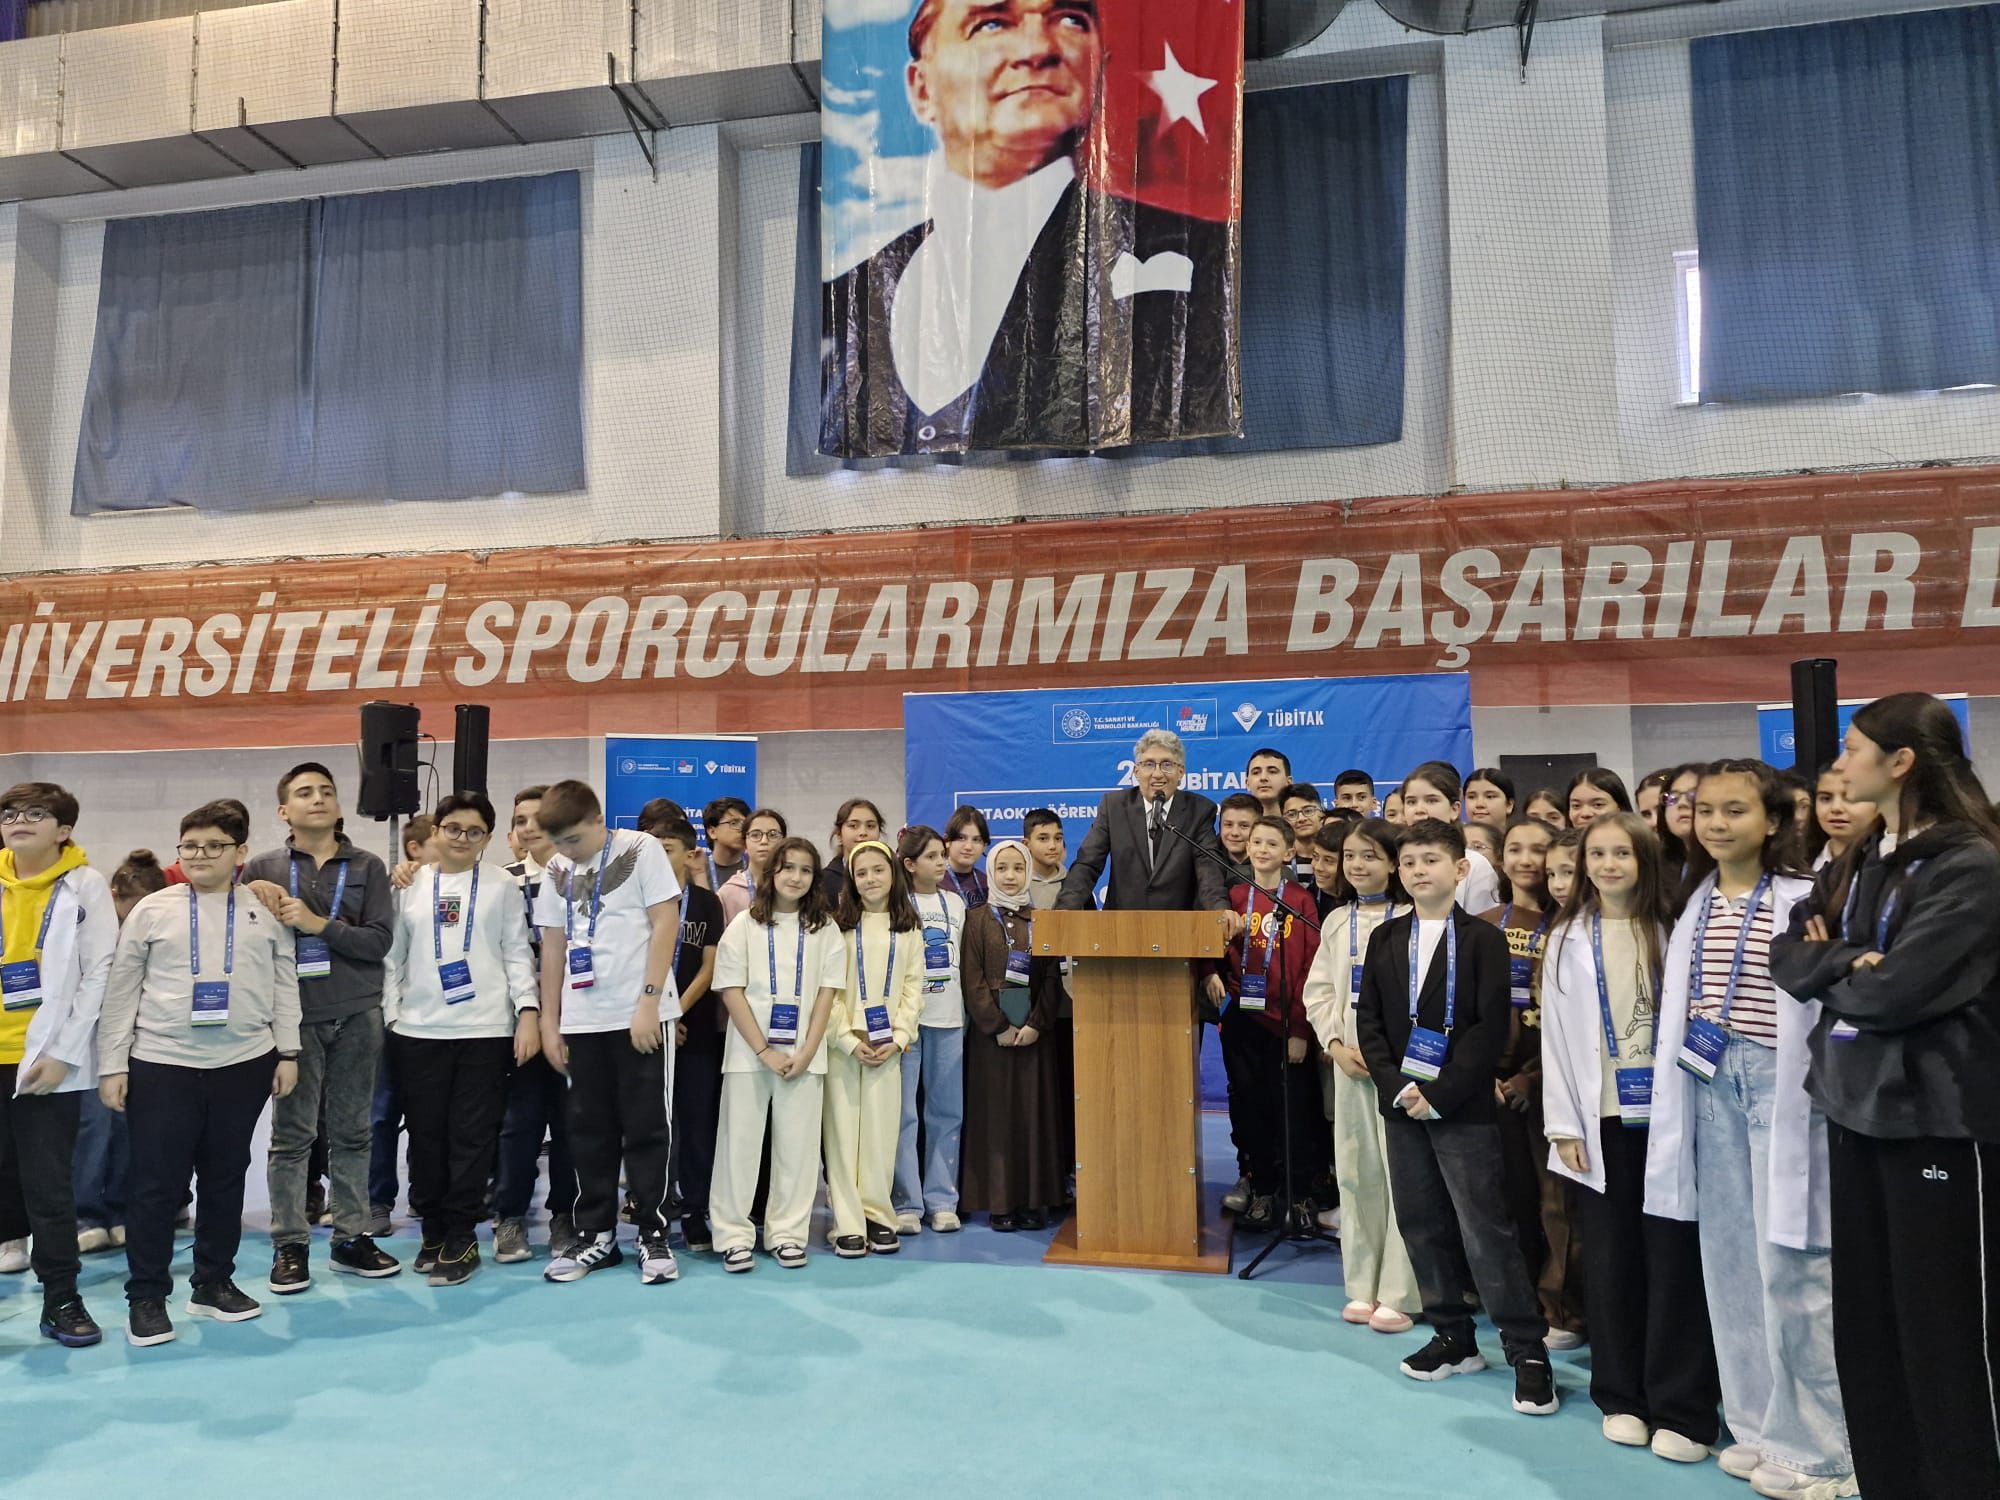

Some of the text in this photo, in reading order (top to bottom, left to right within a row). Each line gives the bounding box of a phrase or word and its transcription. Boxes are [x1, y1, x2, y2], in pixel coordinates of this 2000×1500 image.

[454, 564, 1249, 687] SPORCULARIMIZA
[1286, 531, 1922, 669] BAŞARILAR
[1267, 708, 1324, 727] TÜBİTAK
[1922, 1164, 1949, 1180] alo
